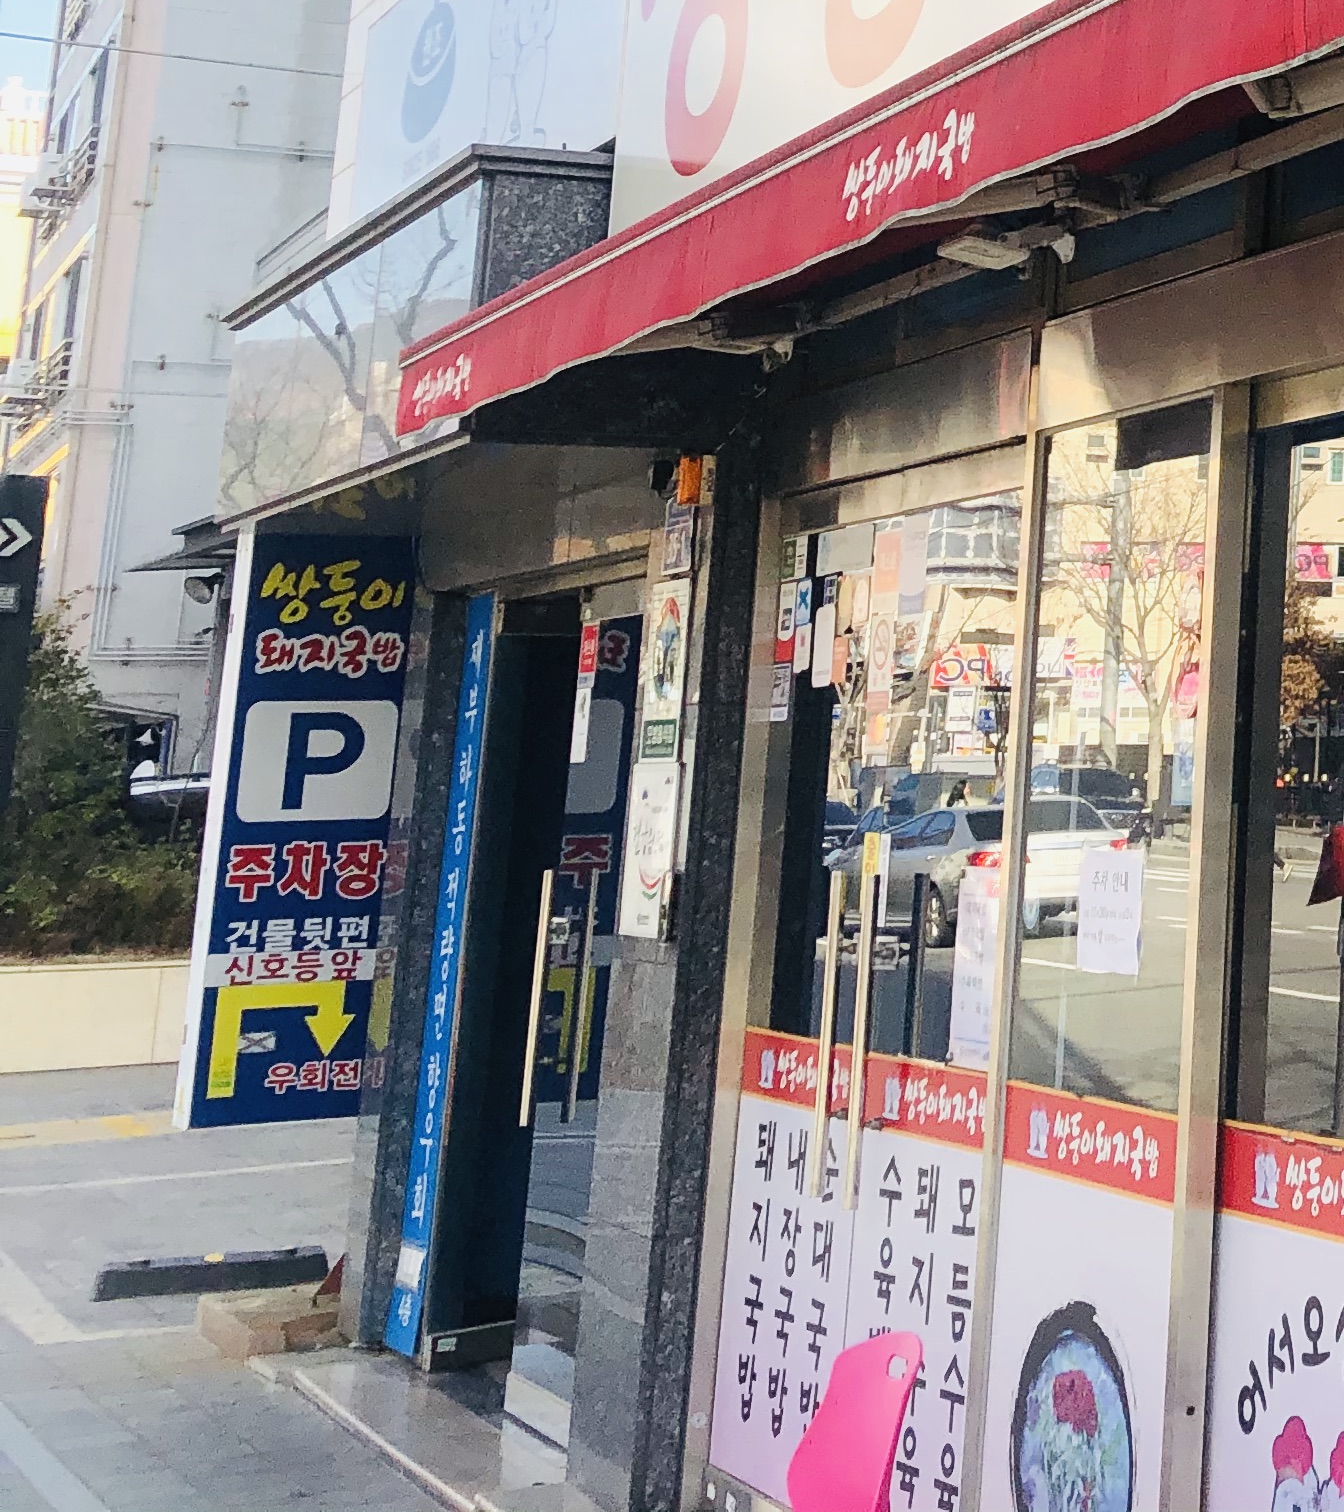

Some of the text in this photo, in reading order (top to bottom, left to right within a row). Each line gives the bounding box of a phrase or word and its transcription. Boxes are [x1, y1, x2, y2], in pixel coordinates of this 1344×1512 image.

[260, 559, 406, 626] 쌍둥이
[256, 625, 404, 678] 돼지국밥
[281, 712, 365, 810] P
[225, 840, 387, 902] 주차장
[264, 1059, 362, 1094] 우회전
[737, 1120, 777, 1423] 돼지국밥
[767, 1129, 808, 1438] 내장국밥
